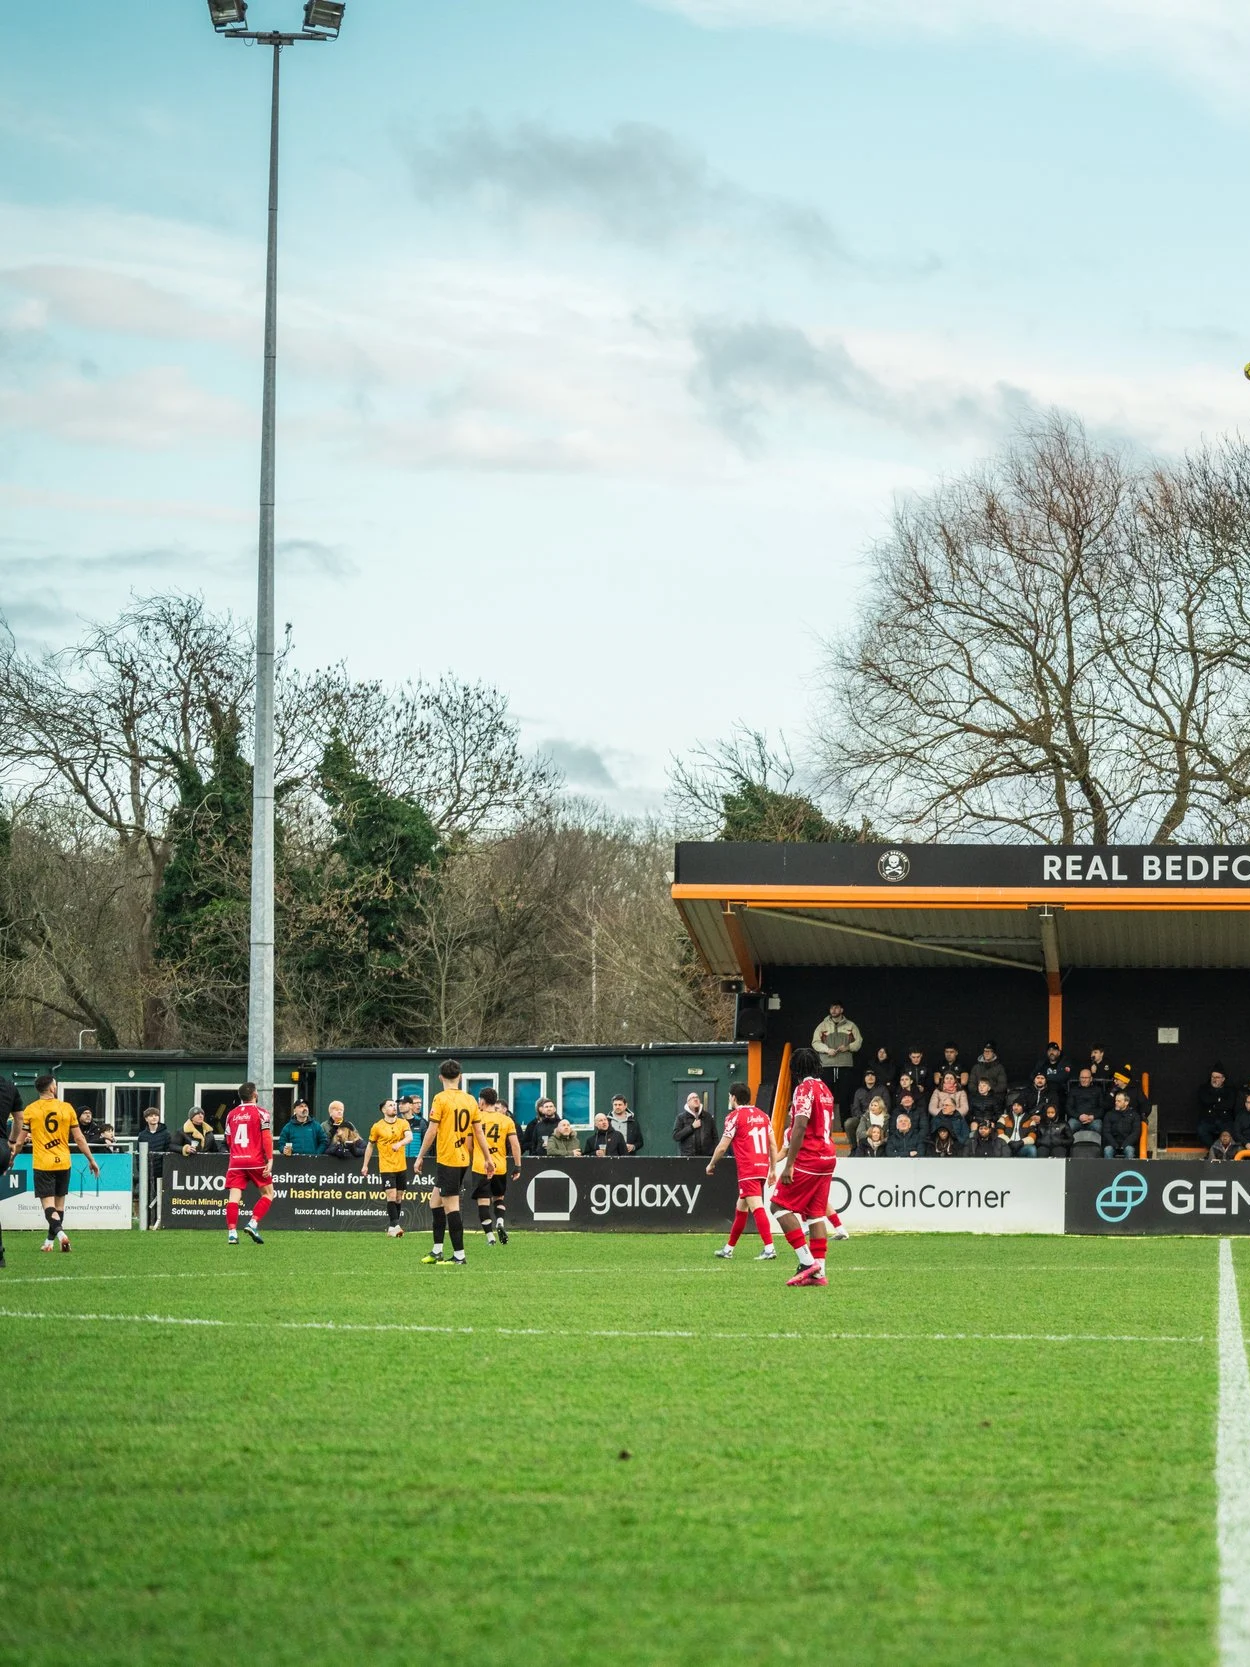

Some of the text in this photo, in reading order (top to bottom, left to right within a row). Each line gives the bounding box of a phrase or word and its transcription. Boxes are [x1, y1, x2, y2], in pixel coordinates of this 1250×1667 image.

[1043, 855, 1128, 881] REAL
[45, 1112, 58, 1134] 6
[453, 1108, 470, 1133] 10
[234, 1123, 249, 1148] 4
[748, 1126, 768, 1154] 11
[172, 1170, 226, 1191] Luxo
[270, 1172, 317, 1184] ashrate
[319, 1173, 345, 1186] paid
[347, 1173, 365, 1184] for
[367, 1174, 382, 1185] thi
[412, 1174, 436, 1185] Ask
[198, 1198, 223, 1207] Mining
[272, 1189, 287, 1198] ow
[290, 1188, 342, 1199] hashrate
[345, 1190, 366, 1200] can
[369, 1190, 386, 1200] wo
[421, 1192, 433, 1203] yo
[590, 1177, 702, 1215] galaxy
[859, 1184, 1011, 1209] CoinCorner
[171, 1208, 206, 1216] Software,
